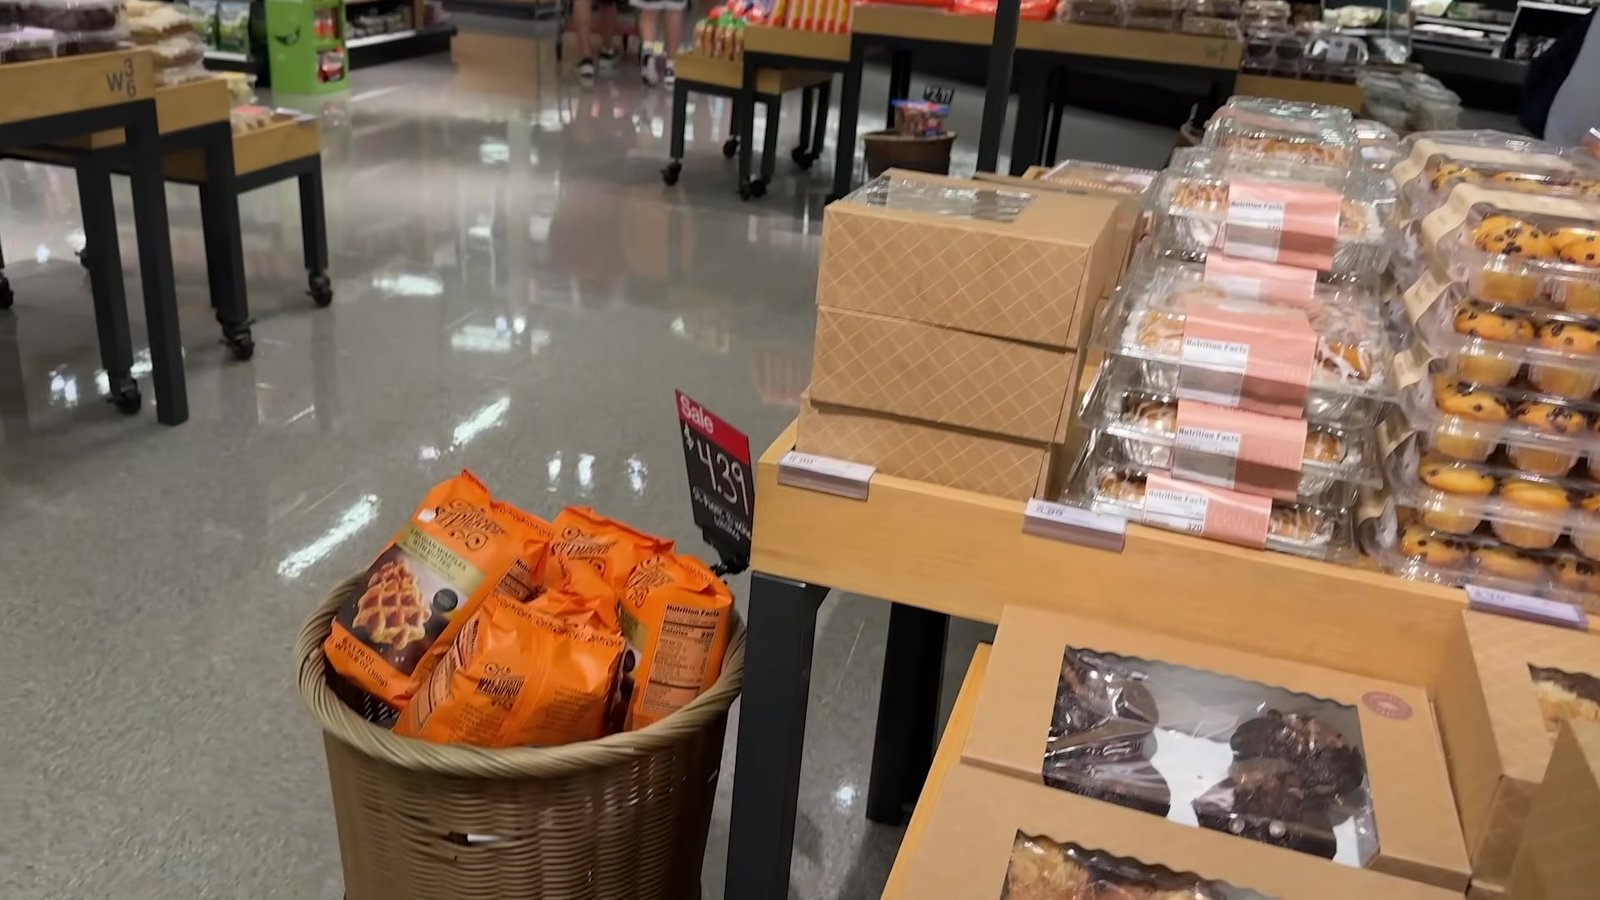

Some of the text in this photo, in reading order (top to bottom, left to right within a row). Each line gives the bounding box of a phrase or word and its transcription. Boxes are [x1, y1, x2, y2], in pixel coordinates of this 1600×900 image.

[106, 70, 123, 92] W
[1230, 200, 1283, 210] Nutrition Facts
[1186, 338, 1247, 354] Nutrition Facts
[680, 394, 714, 434] Sale
[1178, 426, 1239, 443] Nutrition Facts
[1148, 489, 1207, 506] Nutrition Facts
[1185, 522, 1203, 533] 320
[666, 604, 720, 618] Nutrition Facts
[662, 627, 688, 636] Calories
